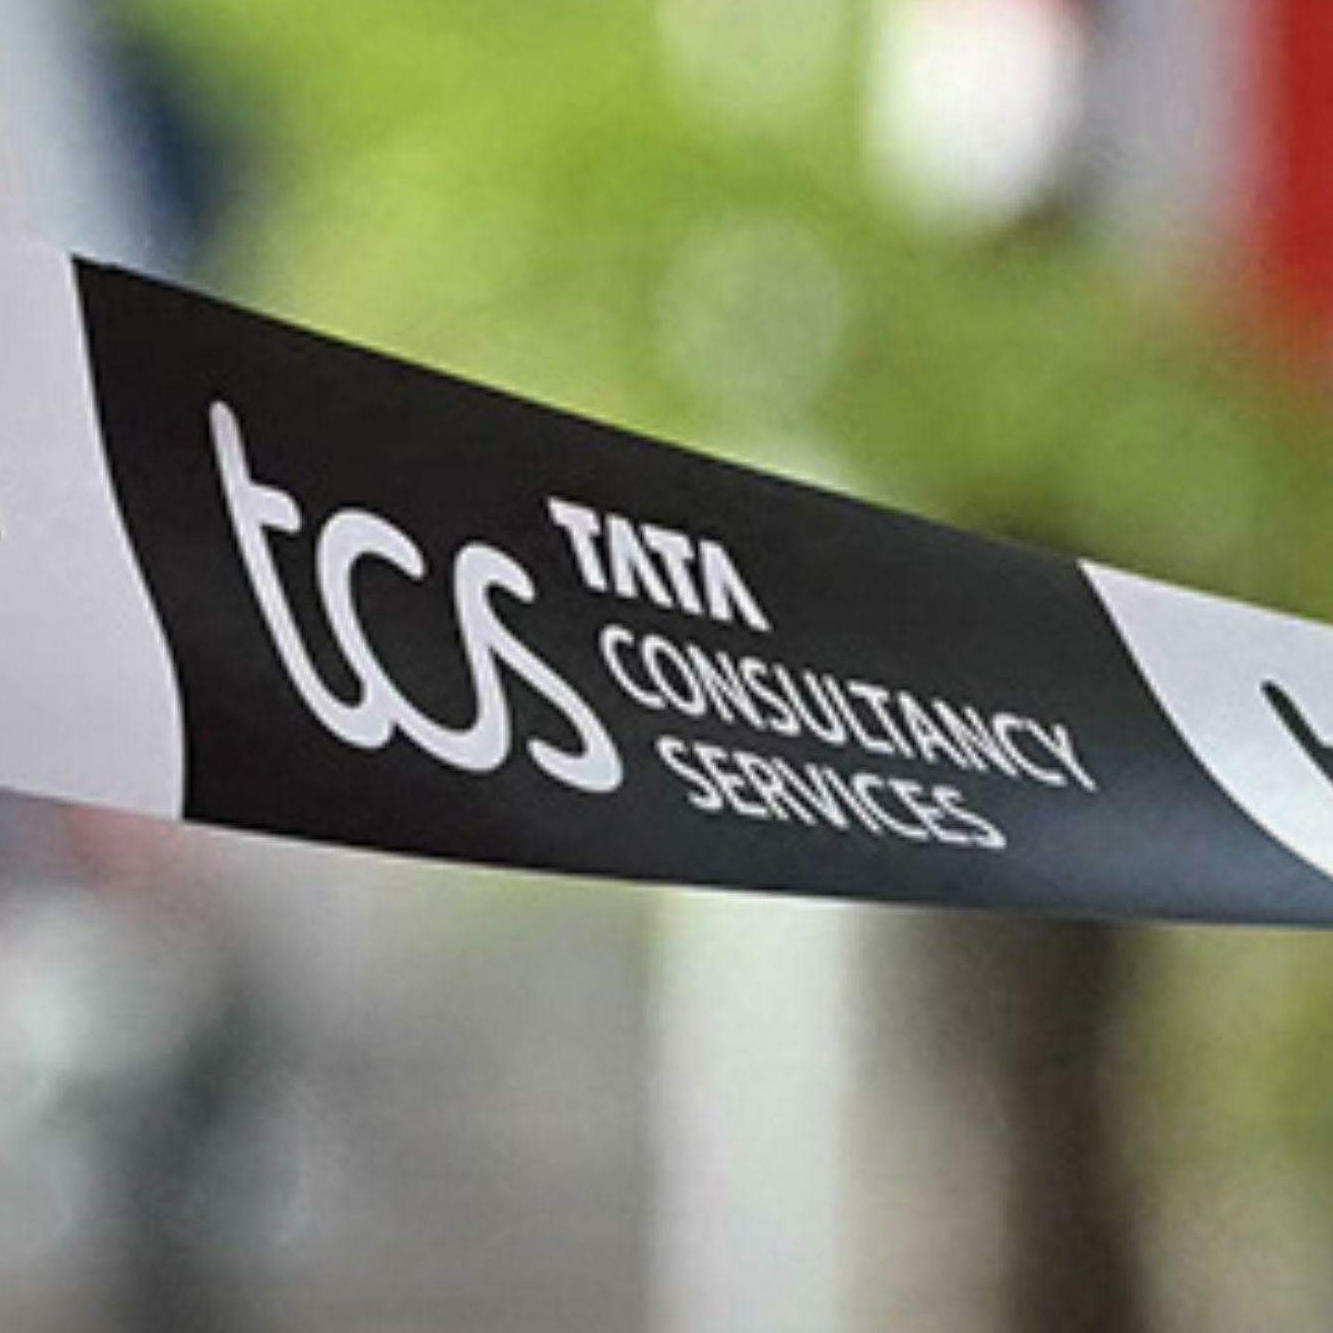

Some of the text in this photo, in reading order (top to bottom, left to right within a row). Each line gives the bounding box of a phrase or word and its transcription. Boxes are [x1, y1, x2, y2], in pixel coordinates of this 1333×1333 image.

[209, 399, 623, 793] tcs
[547, 496, 770, 632] TATA
[598, 623, 1098, 793] CONSULTANCY
[653, 735, 1007, 851] SERVICES
